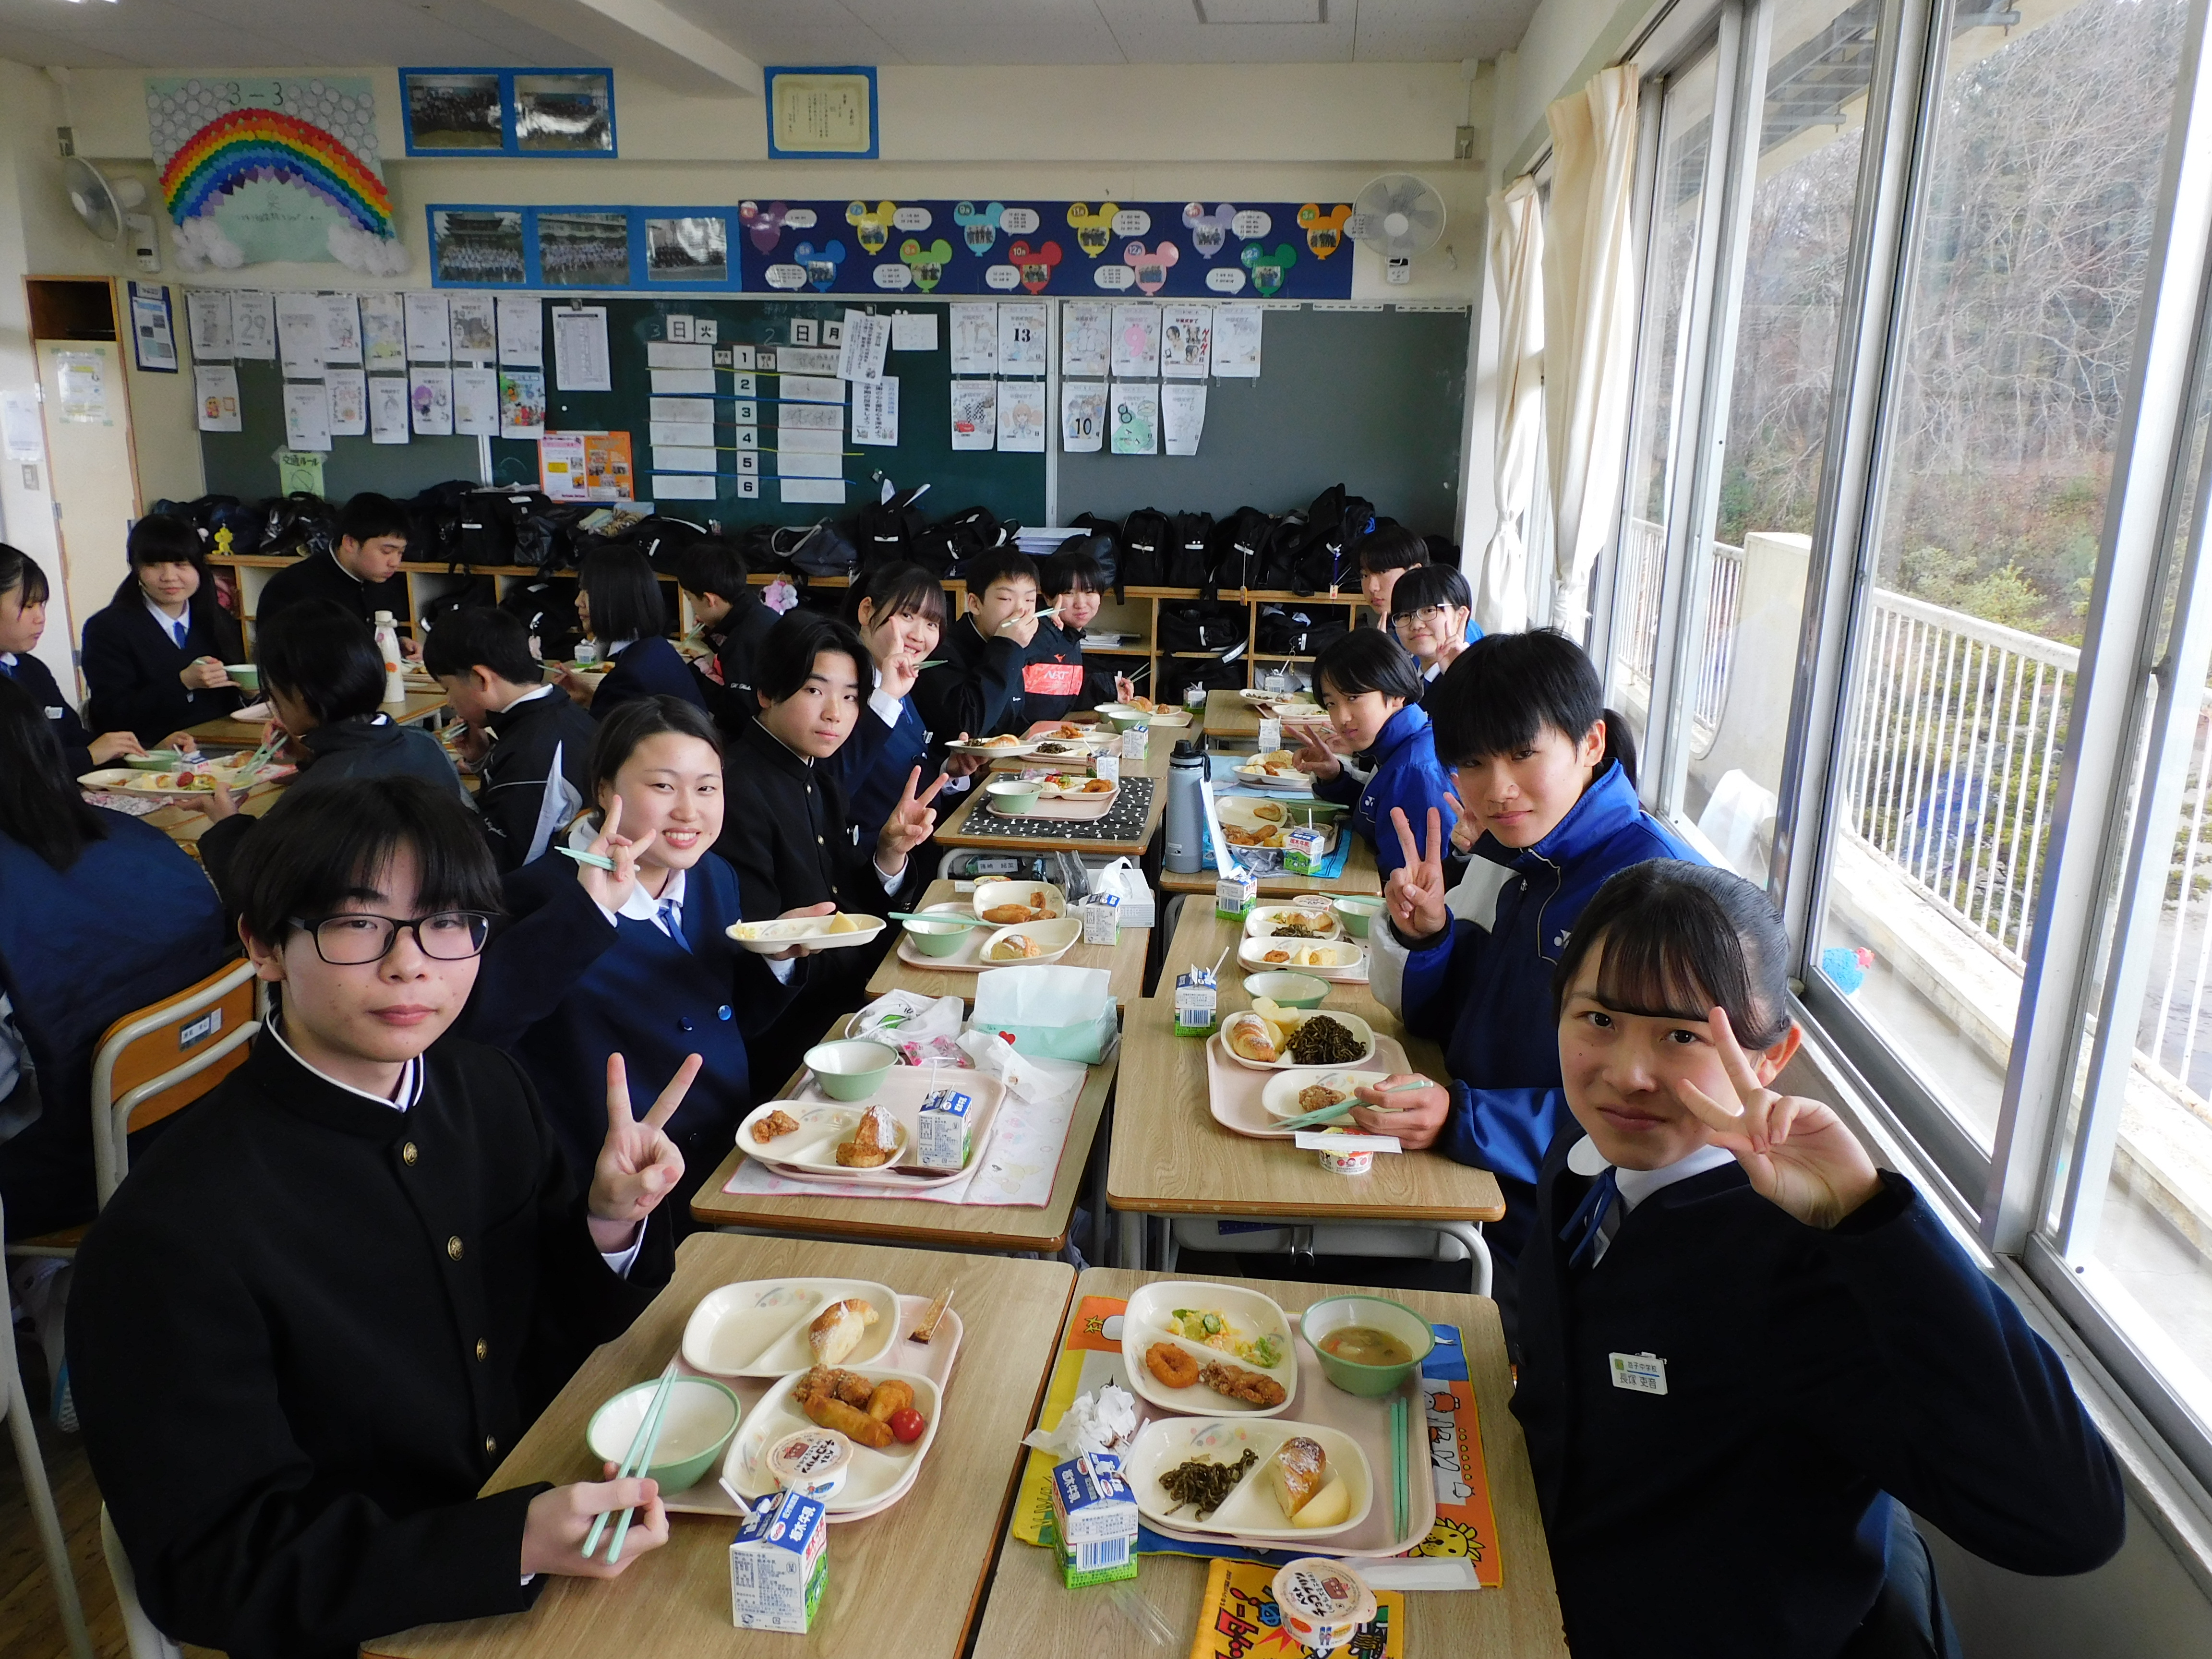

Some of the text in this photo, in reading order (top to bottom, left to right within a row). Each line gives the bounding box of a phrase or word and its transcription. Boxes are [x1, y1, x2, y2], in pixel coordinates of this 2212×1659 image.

[1012, 247, 1026, 256] 10月
[1128, 245, 1142, 255] 12月
[239, 313, 267, 340] 29
[673, 321, 686, 338] 日
[700, 325, 712, 338] 火
[796, 325, 809, 342] 日
[829, 327, 840, 340] 月
[1013, 328, 1031, 342] 13
[1124, 326, 1146, 358] 9
[742, 351, 747, 363] 1
[740, 379, 750, 390] 2
[741, 407, 751, 418] 3
[1075, 418, 1092, 435] 10
[742, 433, 752, 444] 4
[743, 457, 752, 468] 5
[744, 481, 753, 492] 6
[1293, 1586, 1309, 1606] ベスト
[1294, 1572, 1328, 1618] チョコプリン
